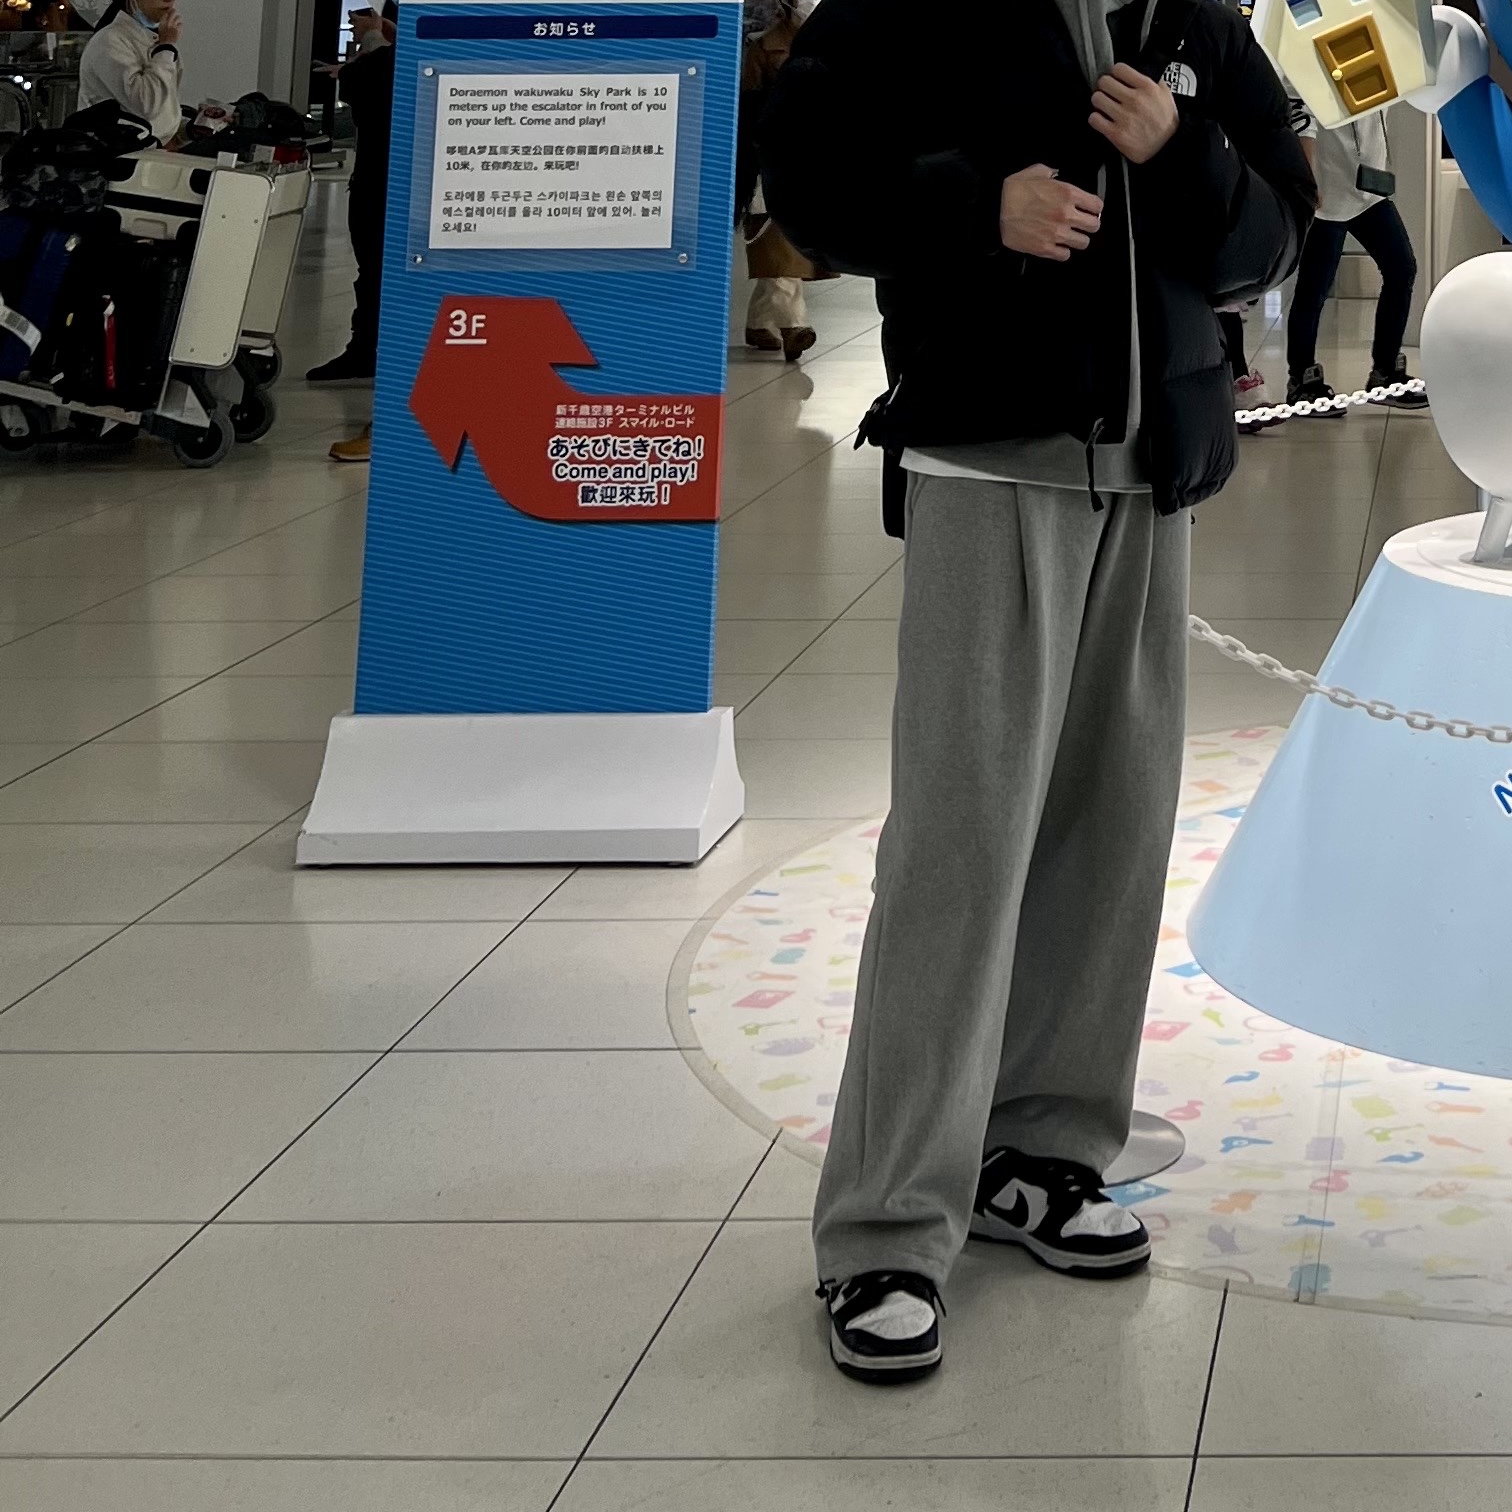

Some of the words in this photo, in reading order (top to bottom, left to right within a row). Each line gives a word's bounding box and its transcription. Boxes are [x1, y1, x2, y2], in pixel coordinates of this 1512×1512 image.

[533, 22, 597, 36] お知らせ
[450, 87, 508, 97] Doraemon
[513, 87, 574, 97] wakuwaku
[579, 87, 600, 100] Sky
[606, 87, 632, 97] Park
[637, 87, 648, 97] is
[653, 87, 668, 97] 10
[449, 102, 488, 112] meters
[491, 104, 506, 114] up
[509, 101, 528, 112] the
[531, 101, 583, 112] escalator
[586, 101, 597, 111] in
[599, 101, 628, 111] front
[631, 101, 643, 111] of
[646, 103, 667, 114] you
[448, 117, 462, 126] on
[465, 117, 492, 128] your
[494, 116, 516, 126] left.
[519, 116, 551, 126] Come
[554, 116, 576, 126] and
[578, 116, 606, 128] play!
[443, 190, 486, 202] 도라에몽
[490, 190, 533, 202] 두근두근
[536, 190, 601, 202] 스카이파크는
[442, 206, 517, 218] 에스컬레이터를
[546, 206, 583, 218] 10미터
[441, 222, 477, 233] 오세요!
[449, 309, 486, 337] 3F
[556, 404, 695, 416] 新千歳空港ターミナルビル
[618, 417, 696, 428] スマイル・ロード
[554, 462, 609, 480] Come
[612, 463, 647, 479] and
[650, 462, 696, 483] play!
